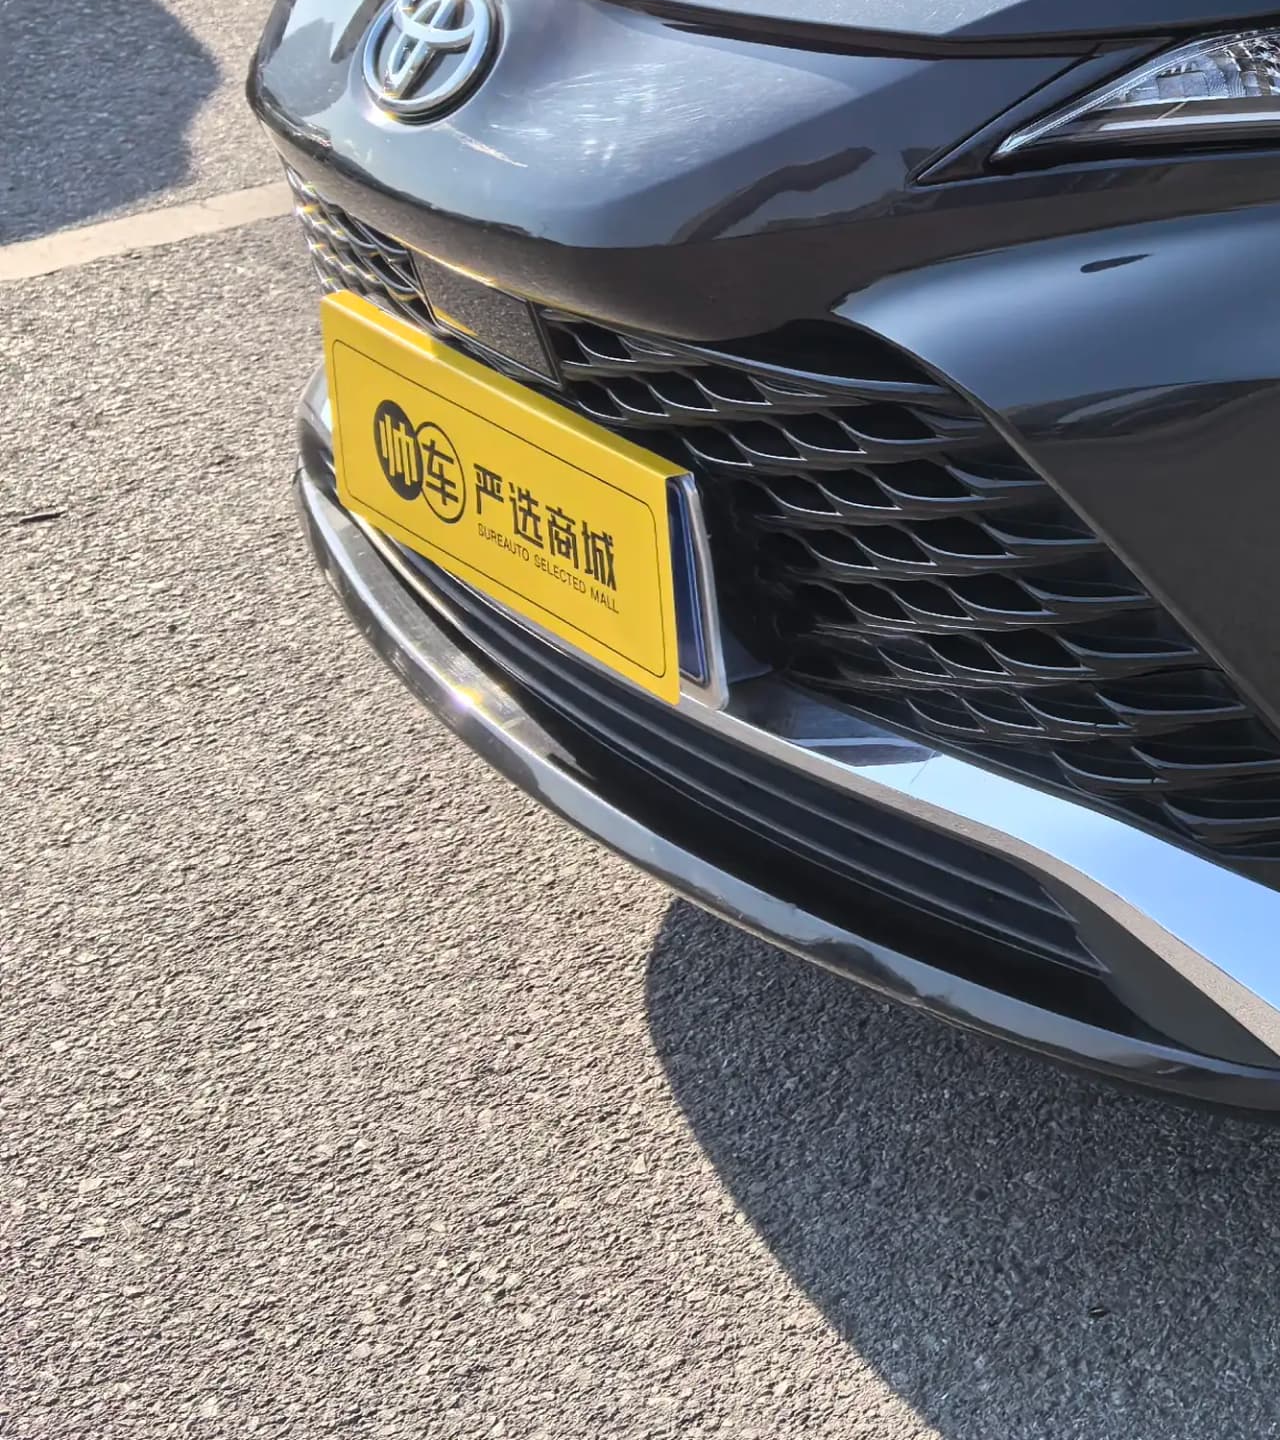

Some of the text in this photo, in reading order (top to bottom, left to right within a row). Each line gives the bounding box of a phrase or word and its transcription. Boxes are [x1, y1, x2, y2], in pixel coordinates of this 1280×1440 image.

[473, 463, 617, 591] 严选商城
[478, 523, 620, 614] SUREAUTO SELECTED MALL
